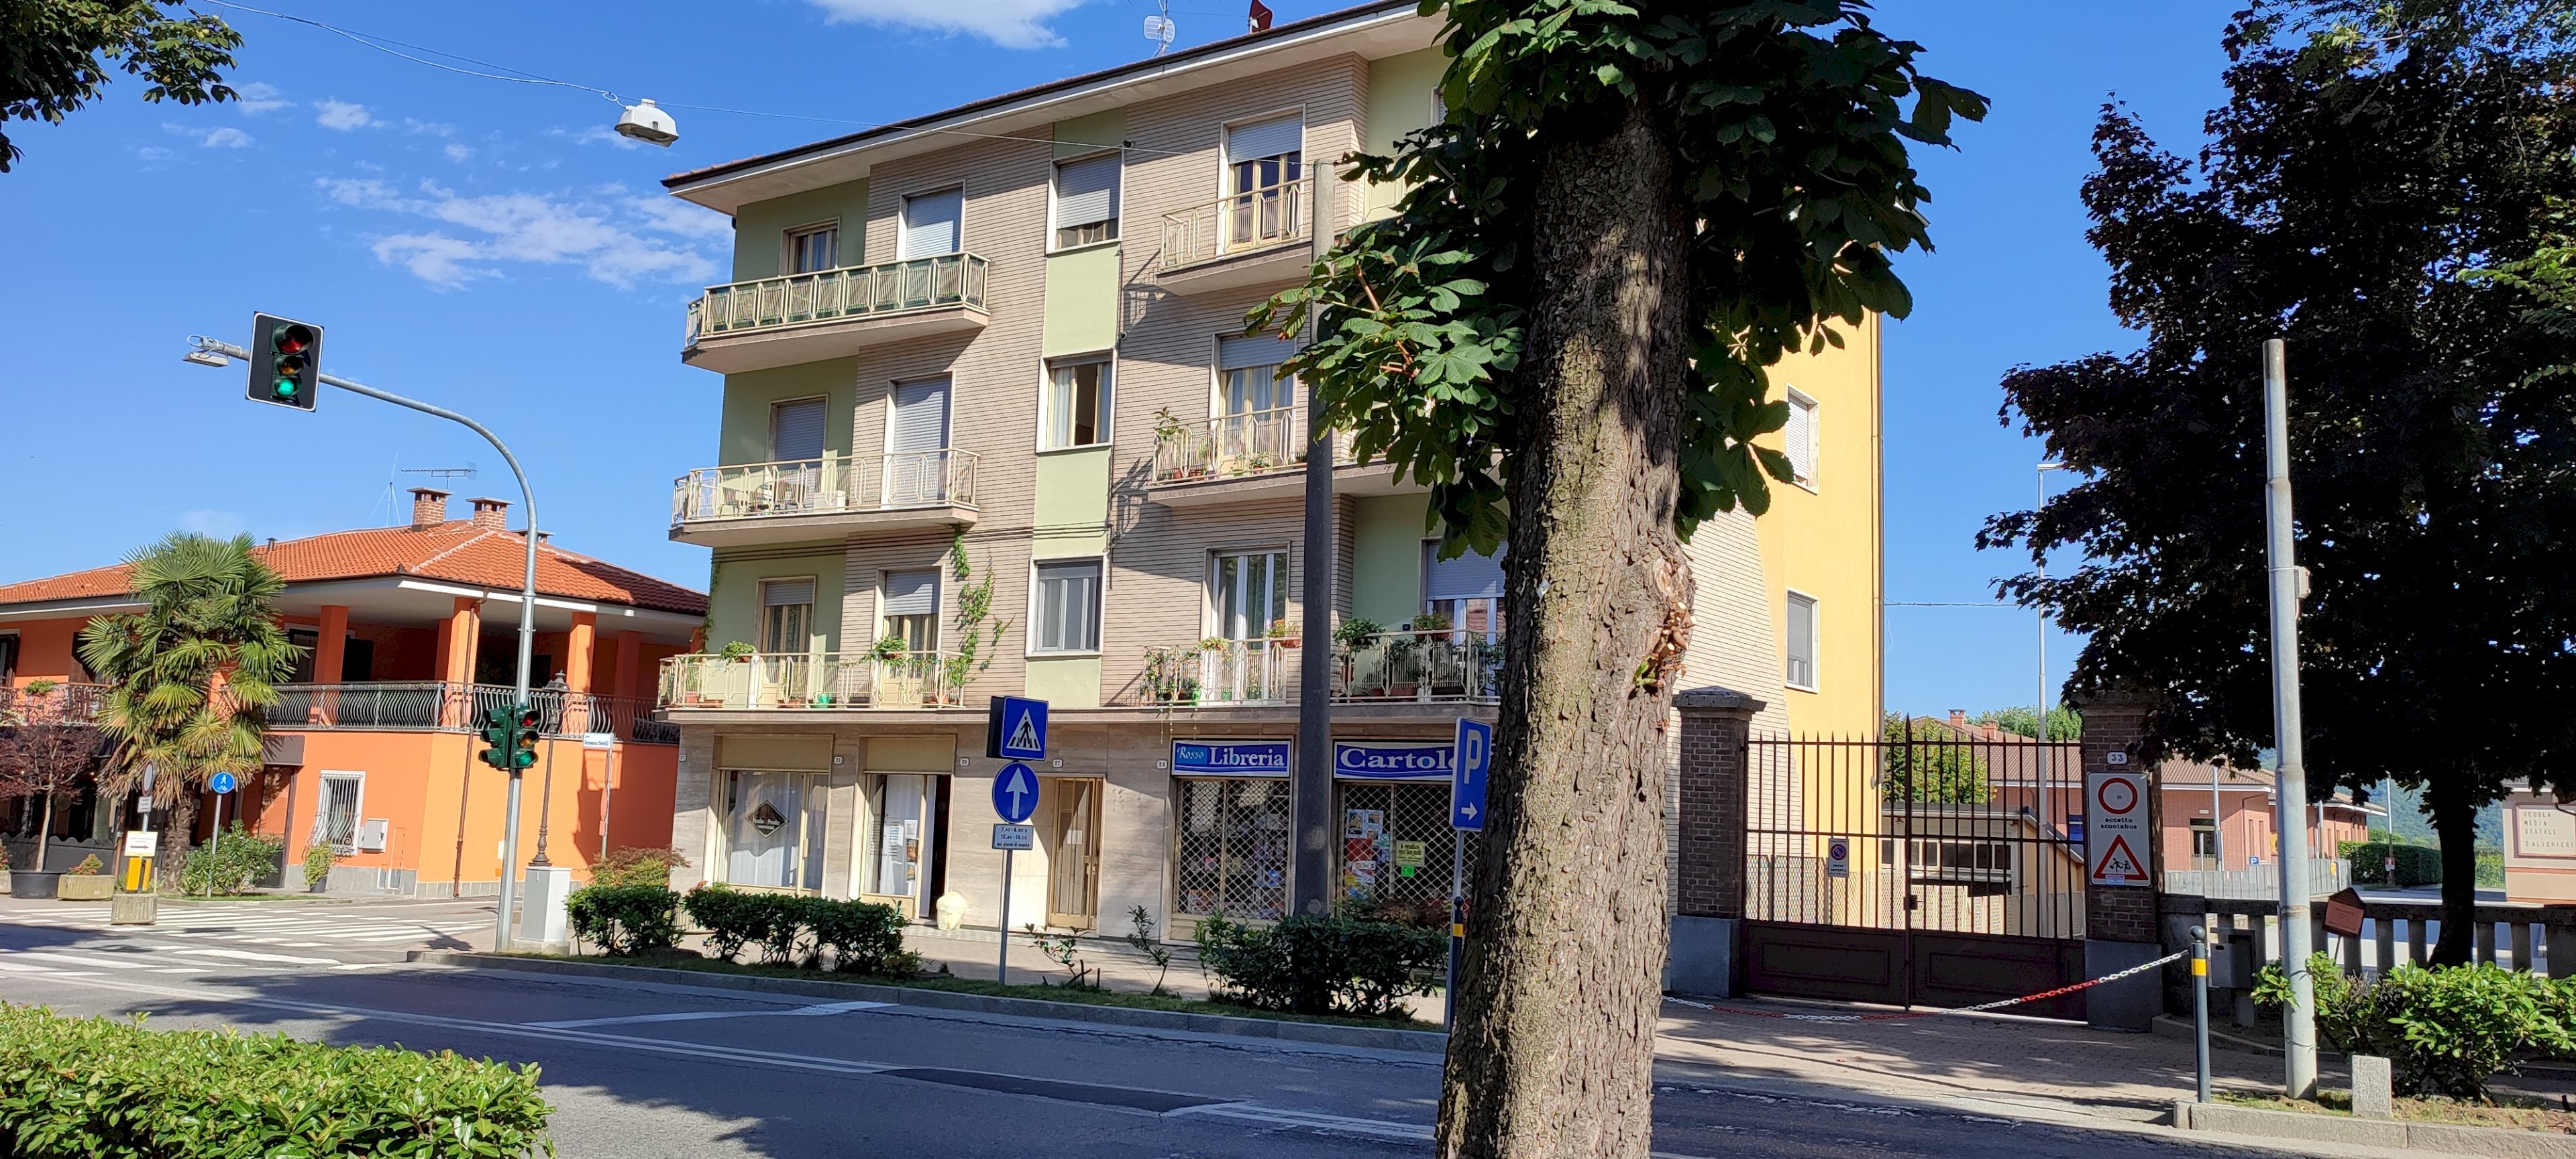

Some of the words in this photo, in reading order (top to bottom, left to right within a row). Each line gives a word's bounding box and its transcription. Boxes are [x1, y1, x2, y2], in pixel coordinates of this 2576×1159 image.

[1177, 746, 1203, 759] Rosso
[1209, 747, 1285, 767] Libreria
[1464, 729, 1483, 784] P
[2111, 754, 2123, 762] 33
